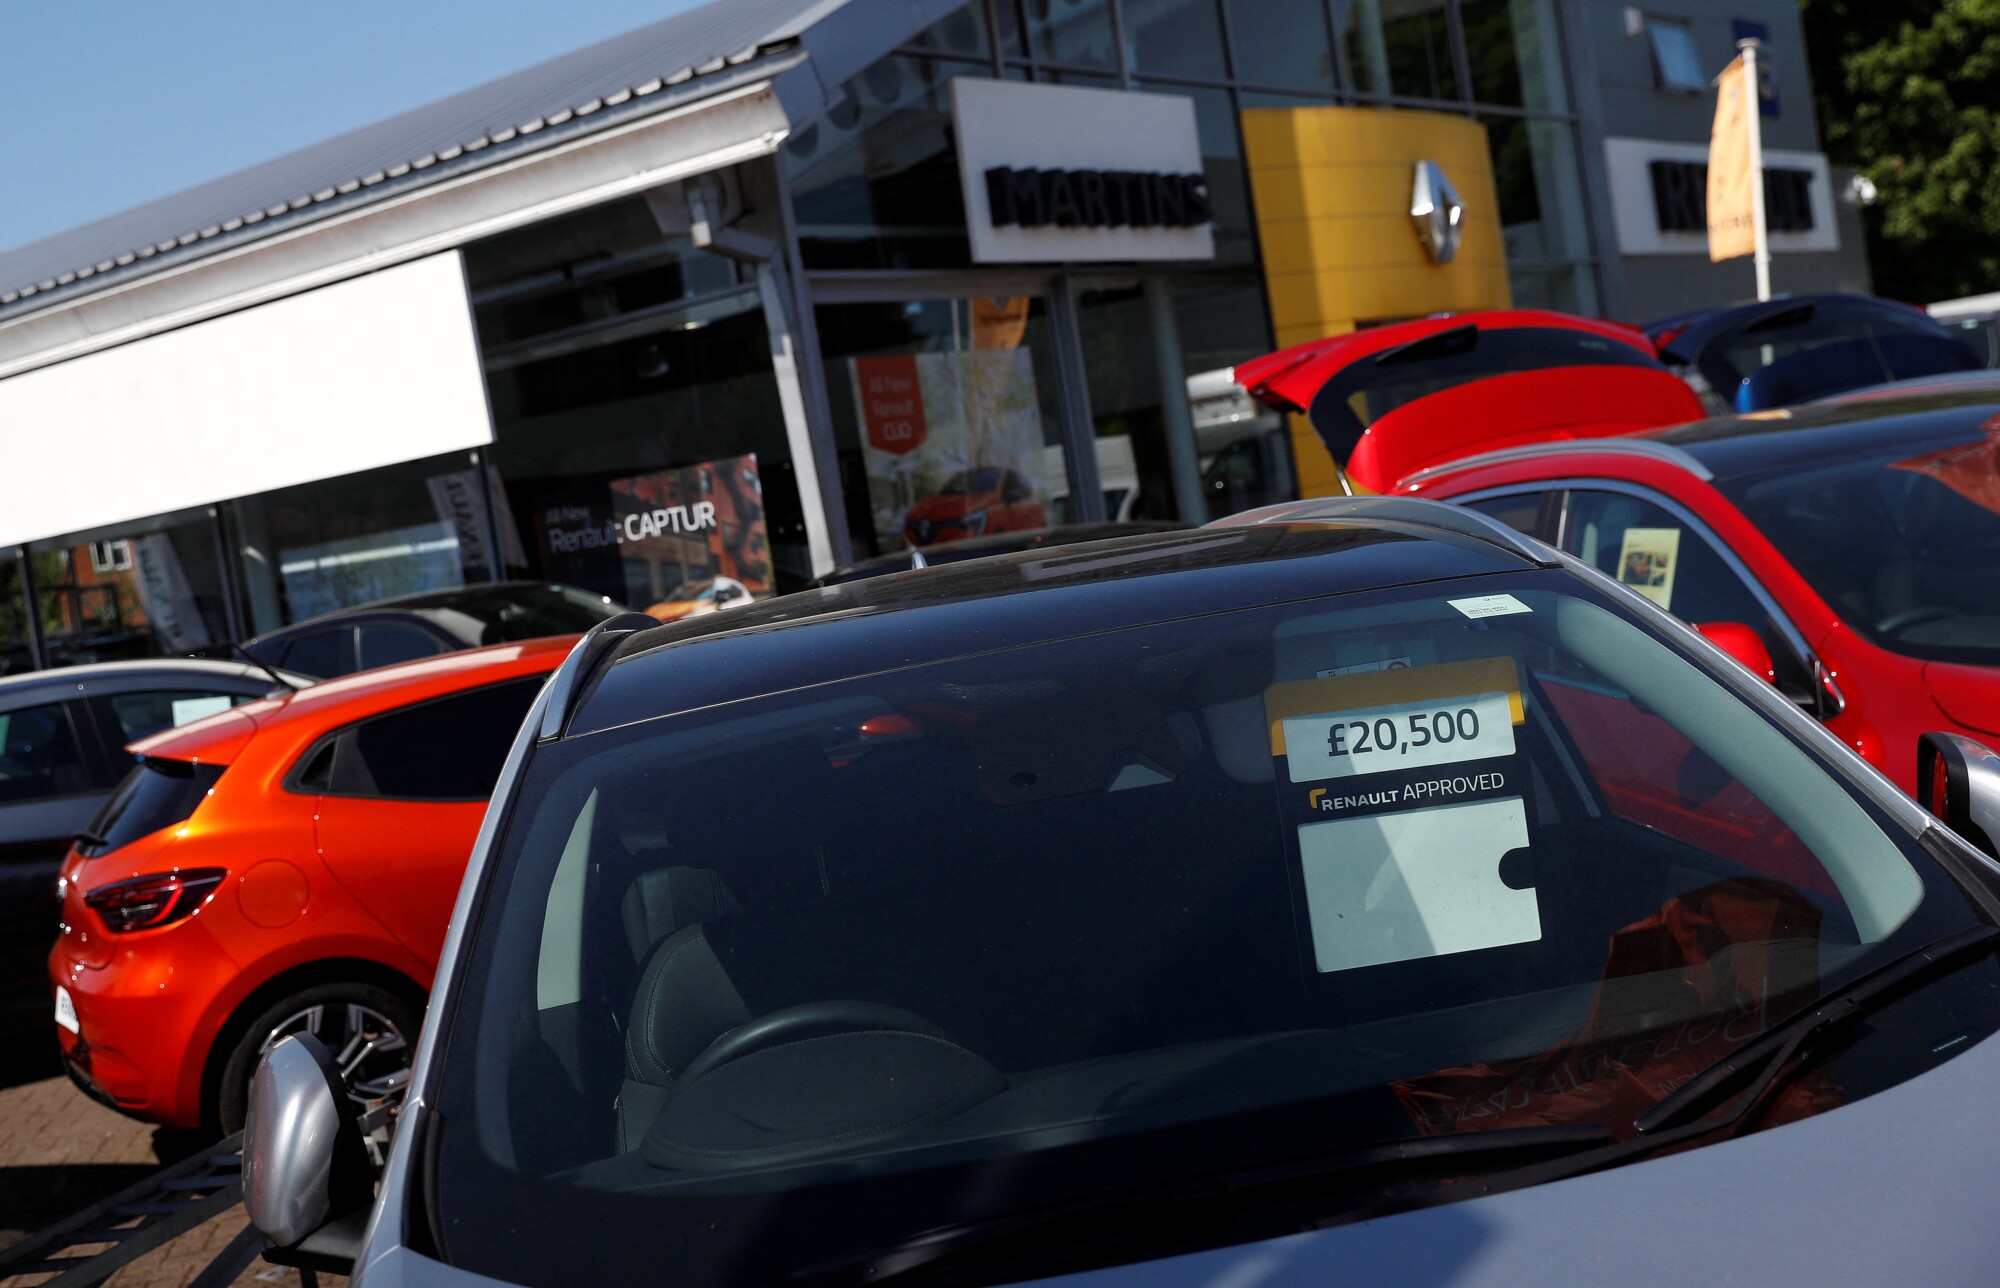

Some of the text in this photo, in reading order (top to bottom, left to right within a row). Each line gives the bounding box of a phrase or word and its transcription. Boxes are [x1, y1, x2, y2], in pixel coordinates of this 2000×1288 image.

[985, 165, 1213, 229] MARTINS
[624, 500, 717, 542] CAPTUR
[1327, 708, 1480, 757] £20,500
[1322, 772, 1505, 811] RENAULT APPROVED
